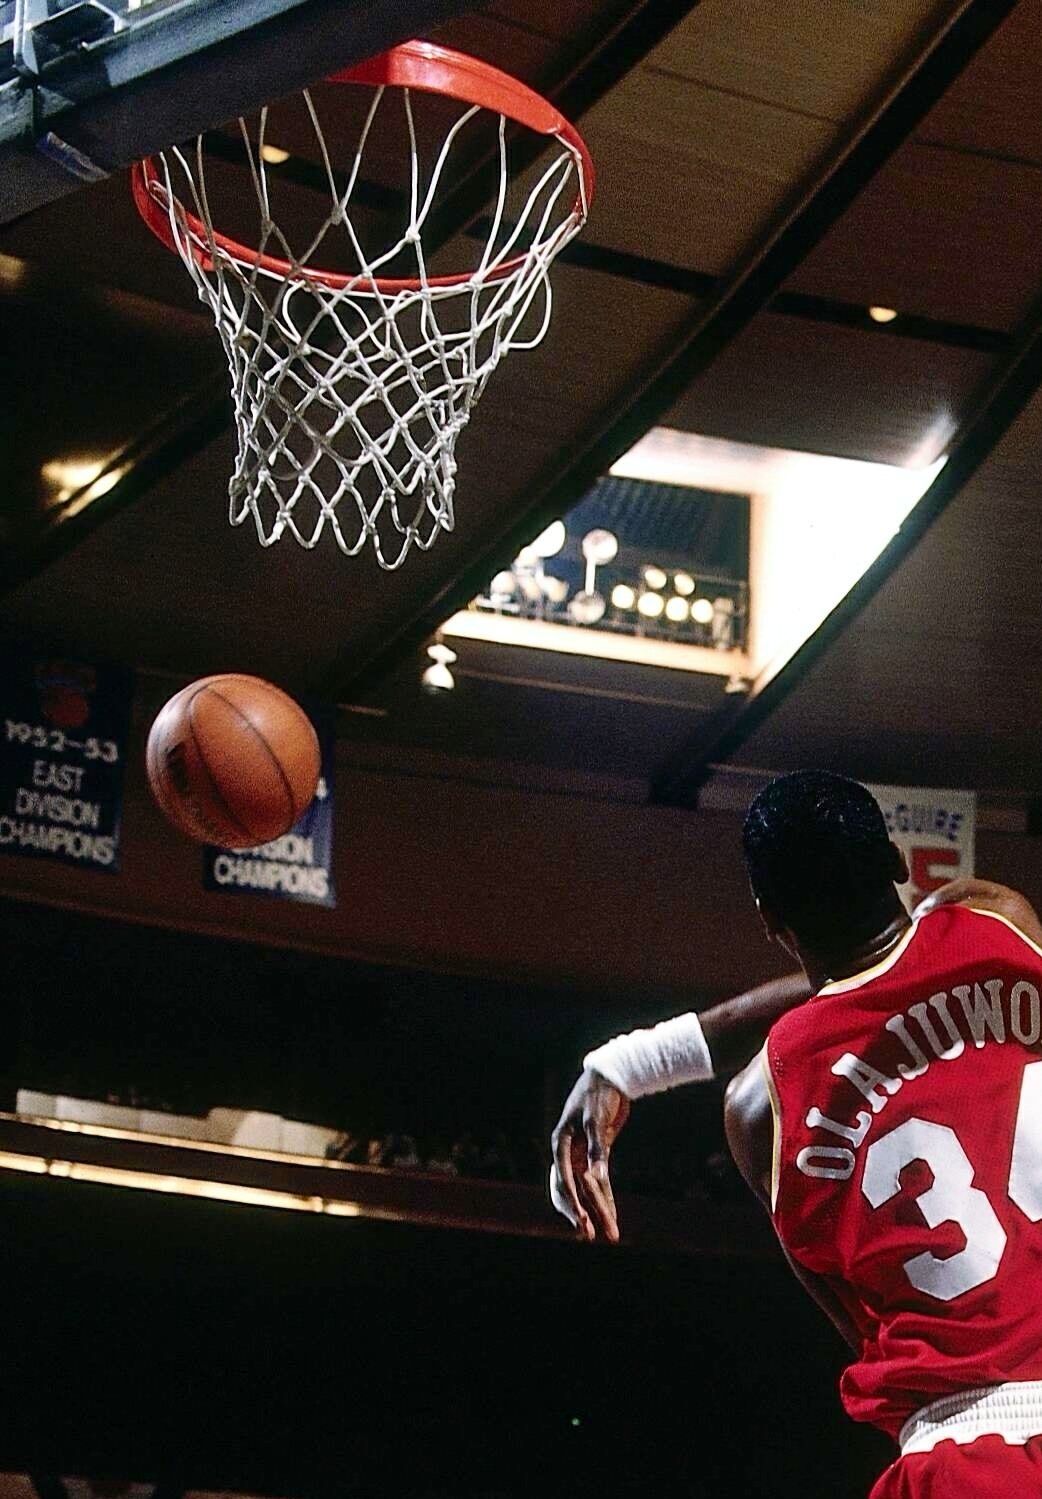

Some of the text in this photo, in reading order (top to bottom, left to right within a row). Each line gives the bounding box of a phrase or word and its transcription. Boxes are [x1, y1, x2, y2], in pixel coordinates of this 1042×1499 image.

[32, 760, 86, 792] EAST
[16, 788, 100, 829] DIVISION
[0, 816, 115, 865] CHAMPIONS
[213, 854, 329, 898] CHAMPIONS
